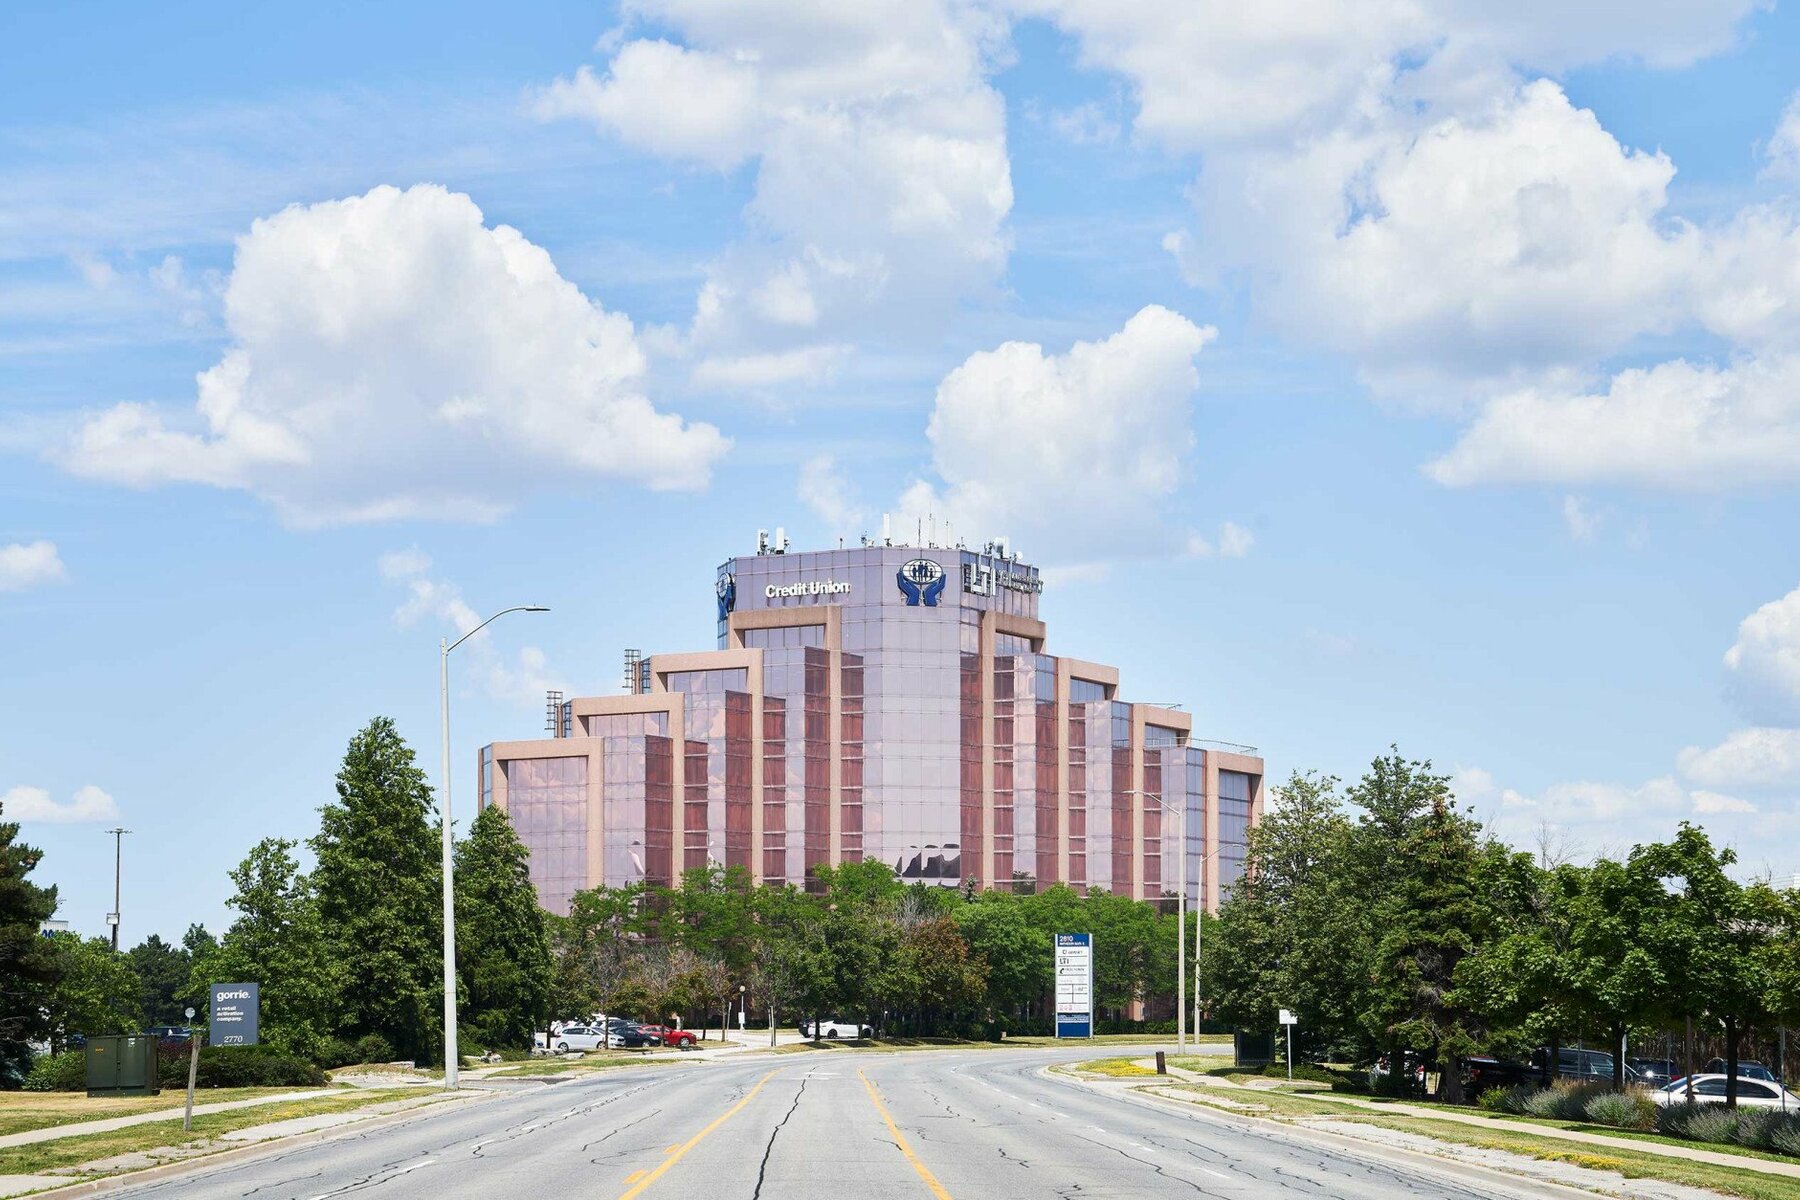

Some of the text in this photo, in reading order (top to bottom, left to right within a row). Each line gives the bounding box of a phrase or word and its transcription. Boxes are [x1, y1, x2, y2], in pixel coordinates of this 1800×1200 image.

[765, 579, 850, 598] Credit Union
[216, 989, 251, 1002] gorrie.
[223, 1035, 243, 1043] 2770
